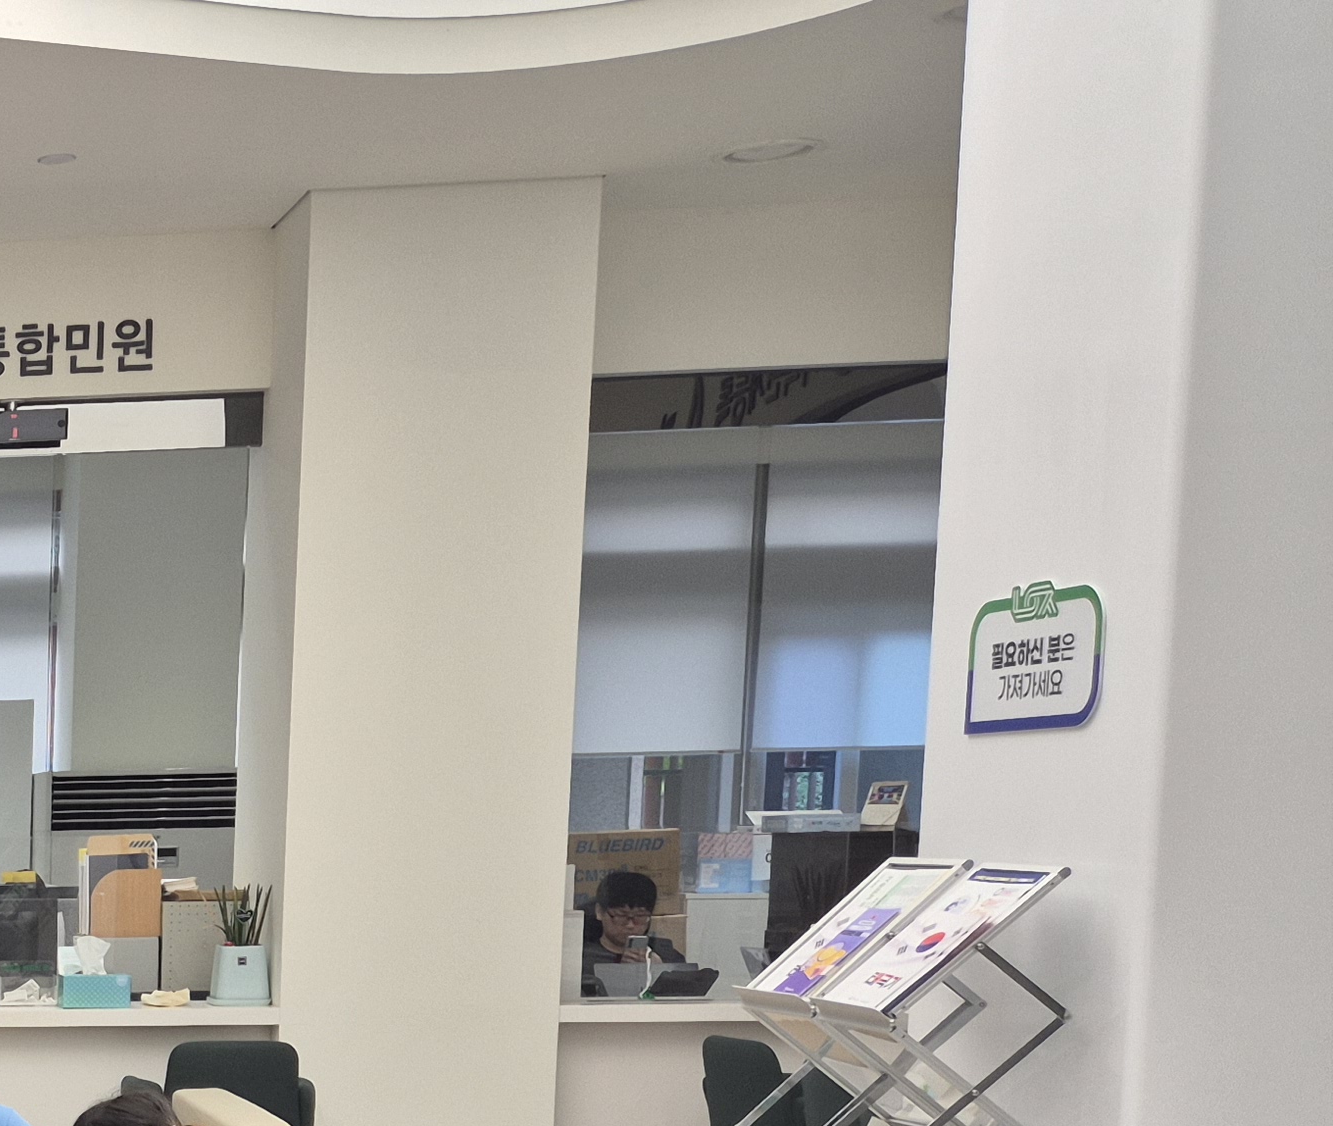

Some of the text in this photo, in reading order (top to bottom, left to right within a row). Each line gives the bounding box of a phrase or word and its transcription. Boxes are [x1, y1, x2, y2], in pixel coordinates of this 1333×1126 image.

[991, 633, 1075, 670] 필요하신 분은
[998, 669, 1063, 701] 가져가세요
[576, 838, 665, 854] BLUEBIRD
